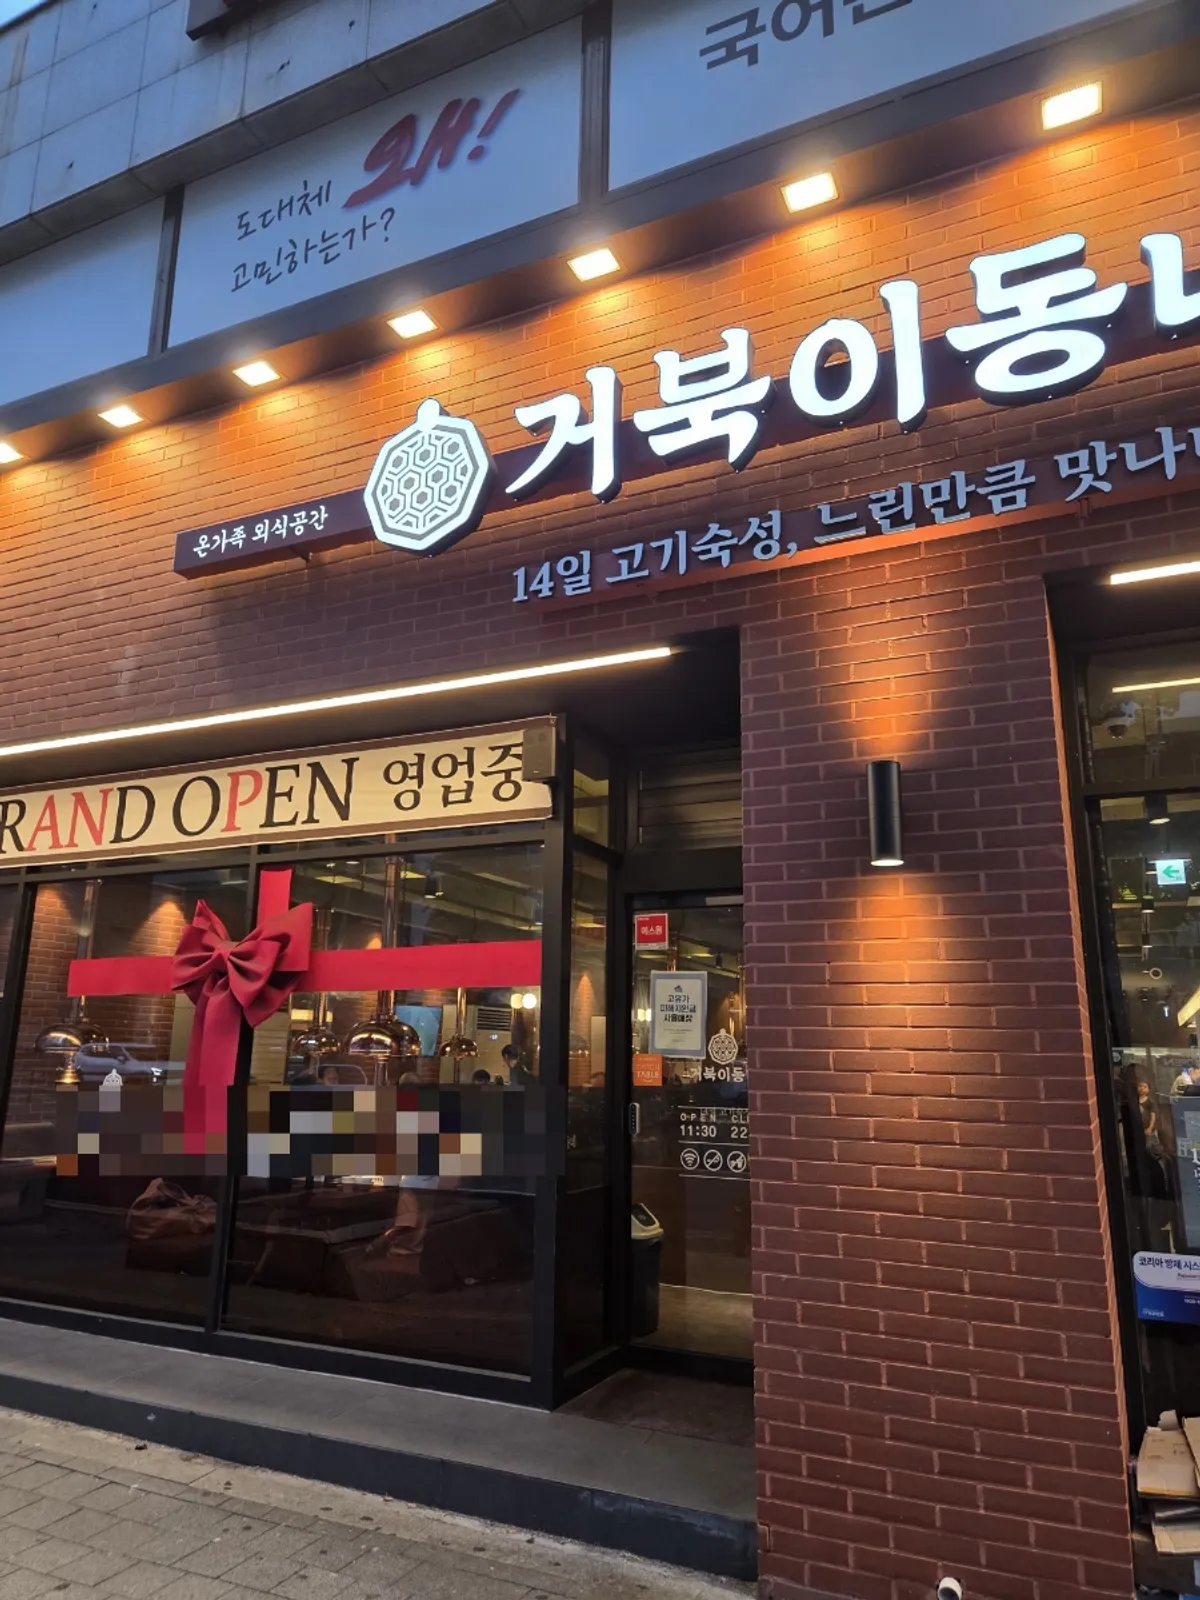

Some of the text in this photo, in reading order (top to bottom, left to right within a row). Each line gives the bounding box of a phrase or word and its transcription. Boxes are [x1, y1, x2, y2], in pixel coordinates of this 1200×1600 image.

[237, 88, 521, 240] 도대체 왜!
[231, 207, 395, 292] 고민하는가?
[193, 505, 328, 558] 온가족 외식공간
[512, 550, 592, 602] 14일
[606, 510, 798, 583] 고기숙성,
[814, 459, 1036, 545] 느린만큼
[172, 756, 360, 837] OPEN
[383, 741, 523, 812] 영업중
[680, 1124, 717, 1138] 11:30
[731, 1114, 749, 1124] CL
[1138, 1256, 1164, 1268] 코리아
